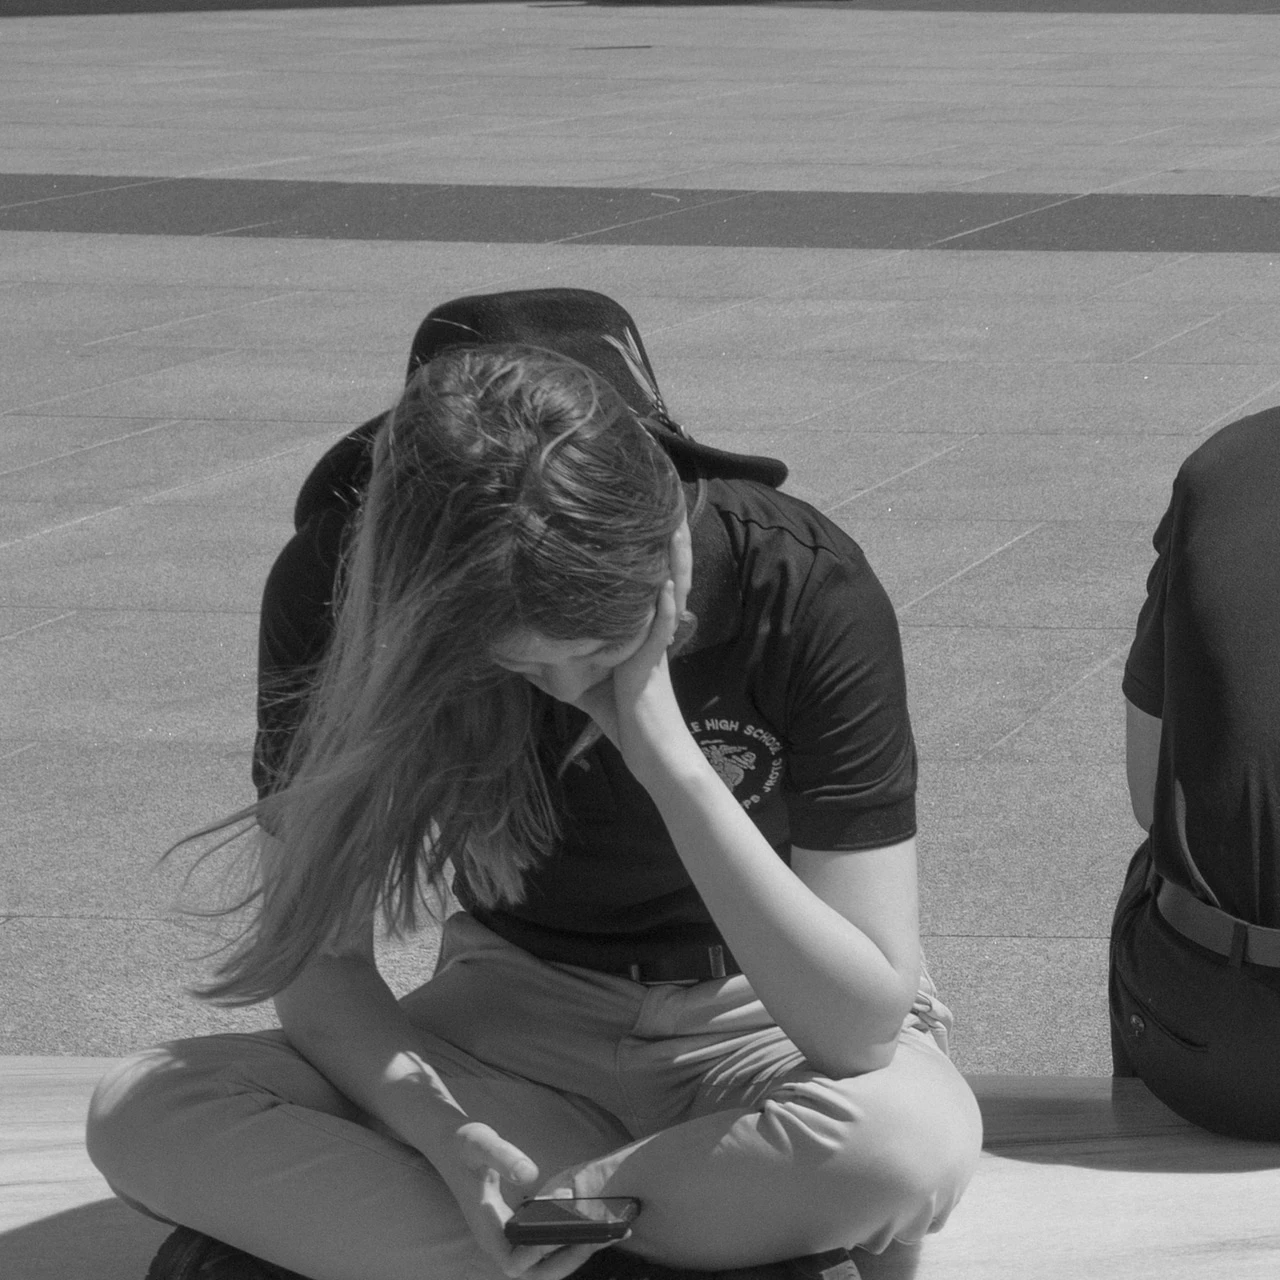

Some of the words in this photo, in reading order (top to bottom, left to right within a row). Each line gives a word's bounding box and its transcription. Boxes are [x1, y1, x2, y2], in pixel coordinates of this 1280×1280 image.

[704, 718, 740, 732] HIGH
[743, 724, 783, 756] SCHOOL
[762, 758, 783, 793] JROTC
